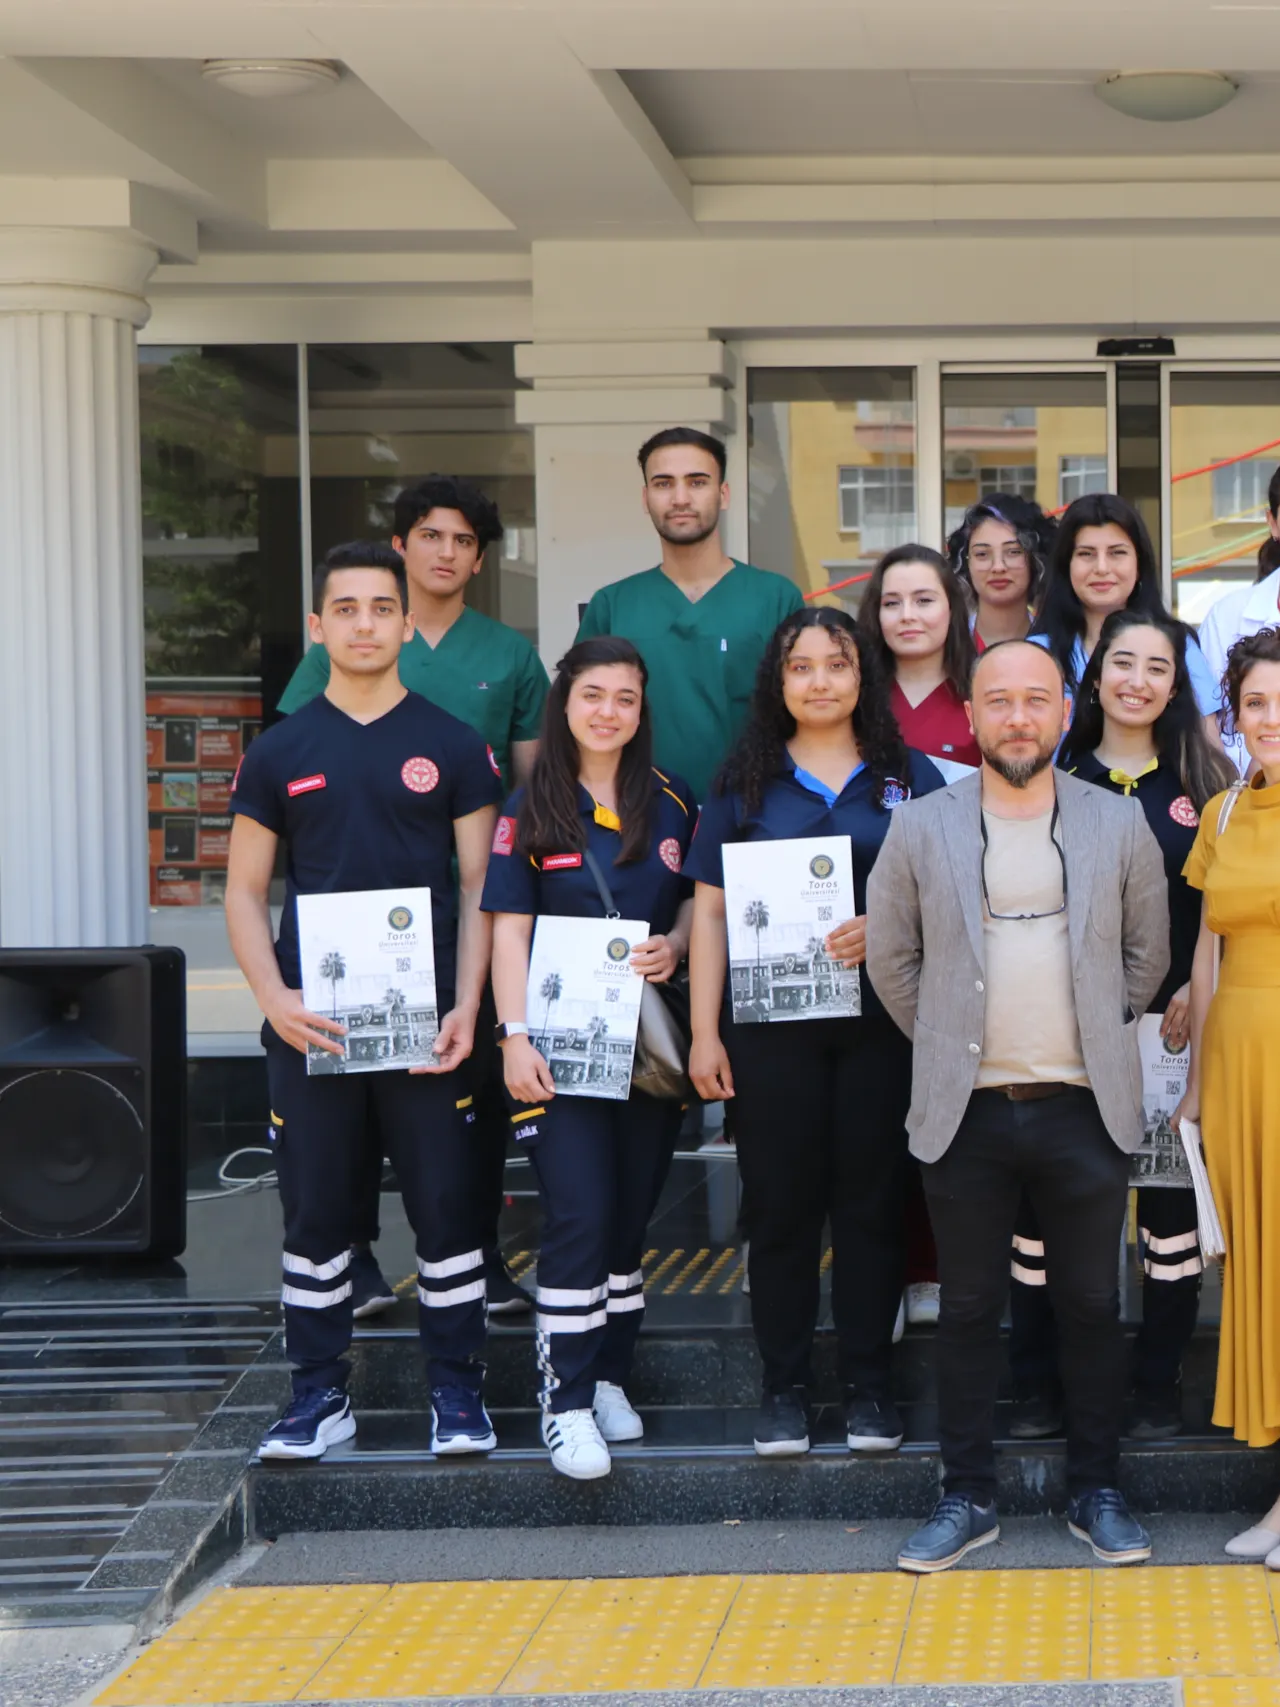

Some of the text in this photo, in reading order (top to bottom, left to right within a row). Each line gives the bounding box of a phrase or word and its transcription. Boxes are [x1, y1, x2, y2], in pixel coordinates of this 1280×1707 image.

[809, 881, 838, 889] Toros
[387, 932, 417, 940] Toros
[603, 962, 631, 971] Toros
[1160, 1055, 1189, 1064] Toros
